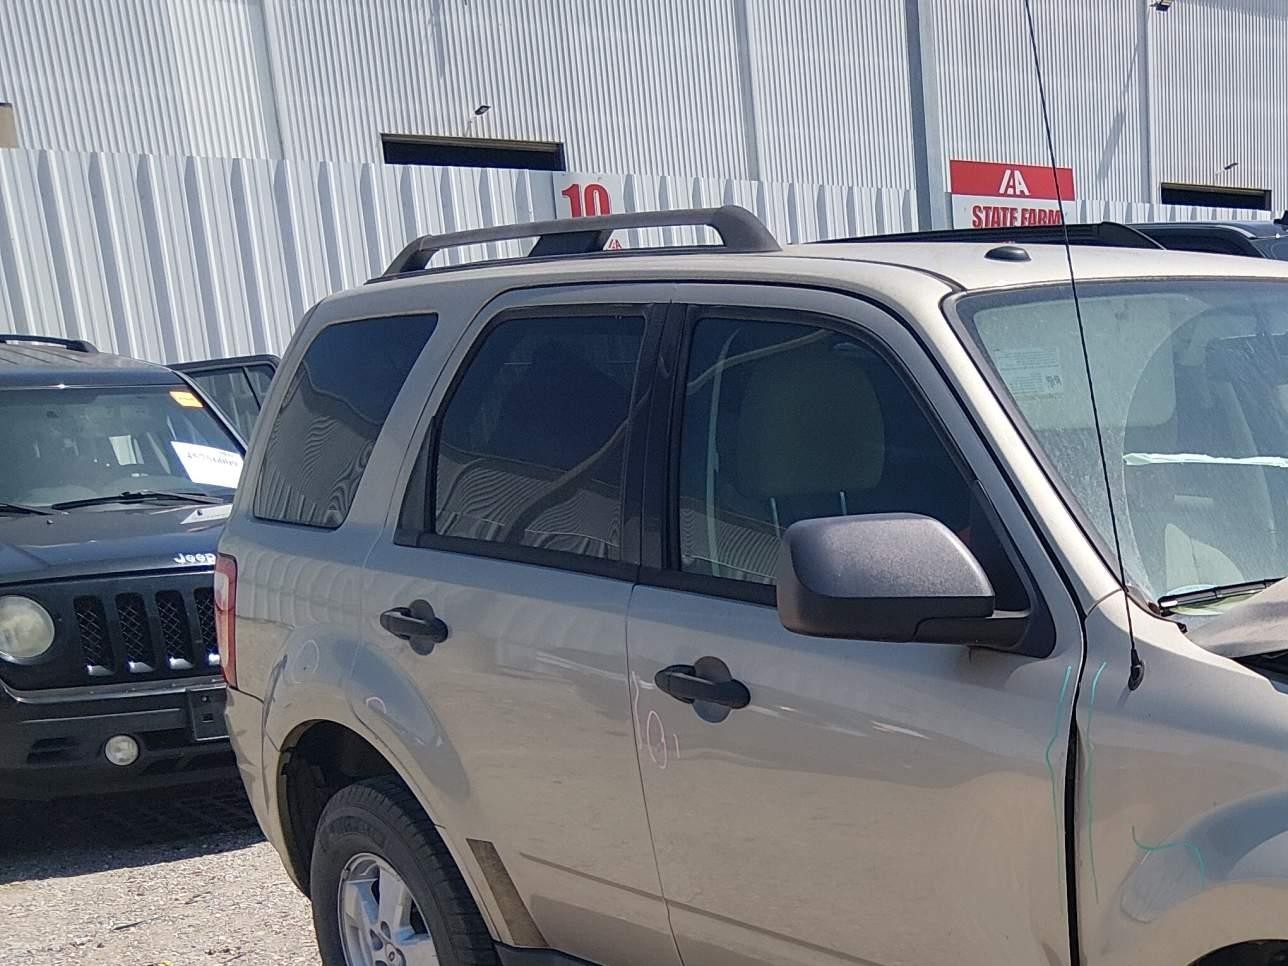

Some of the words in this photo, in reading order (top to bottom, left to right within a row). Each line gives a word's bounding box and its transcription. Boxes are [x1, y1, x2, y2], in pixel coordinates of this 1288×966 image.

[561, 184, 611, 218] 10
[972, 205, 1018, 229] STATE
[1020, 207, 1062, 226] FARM
